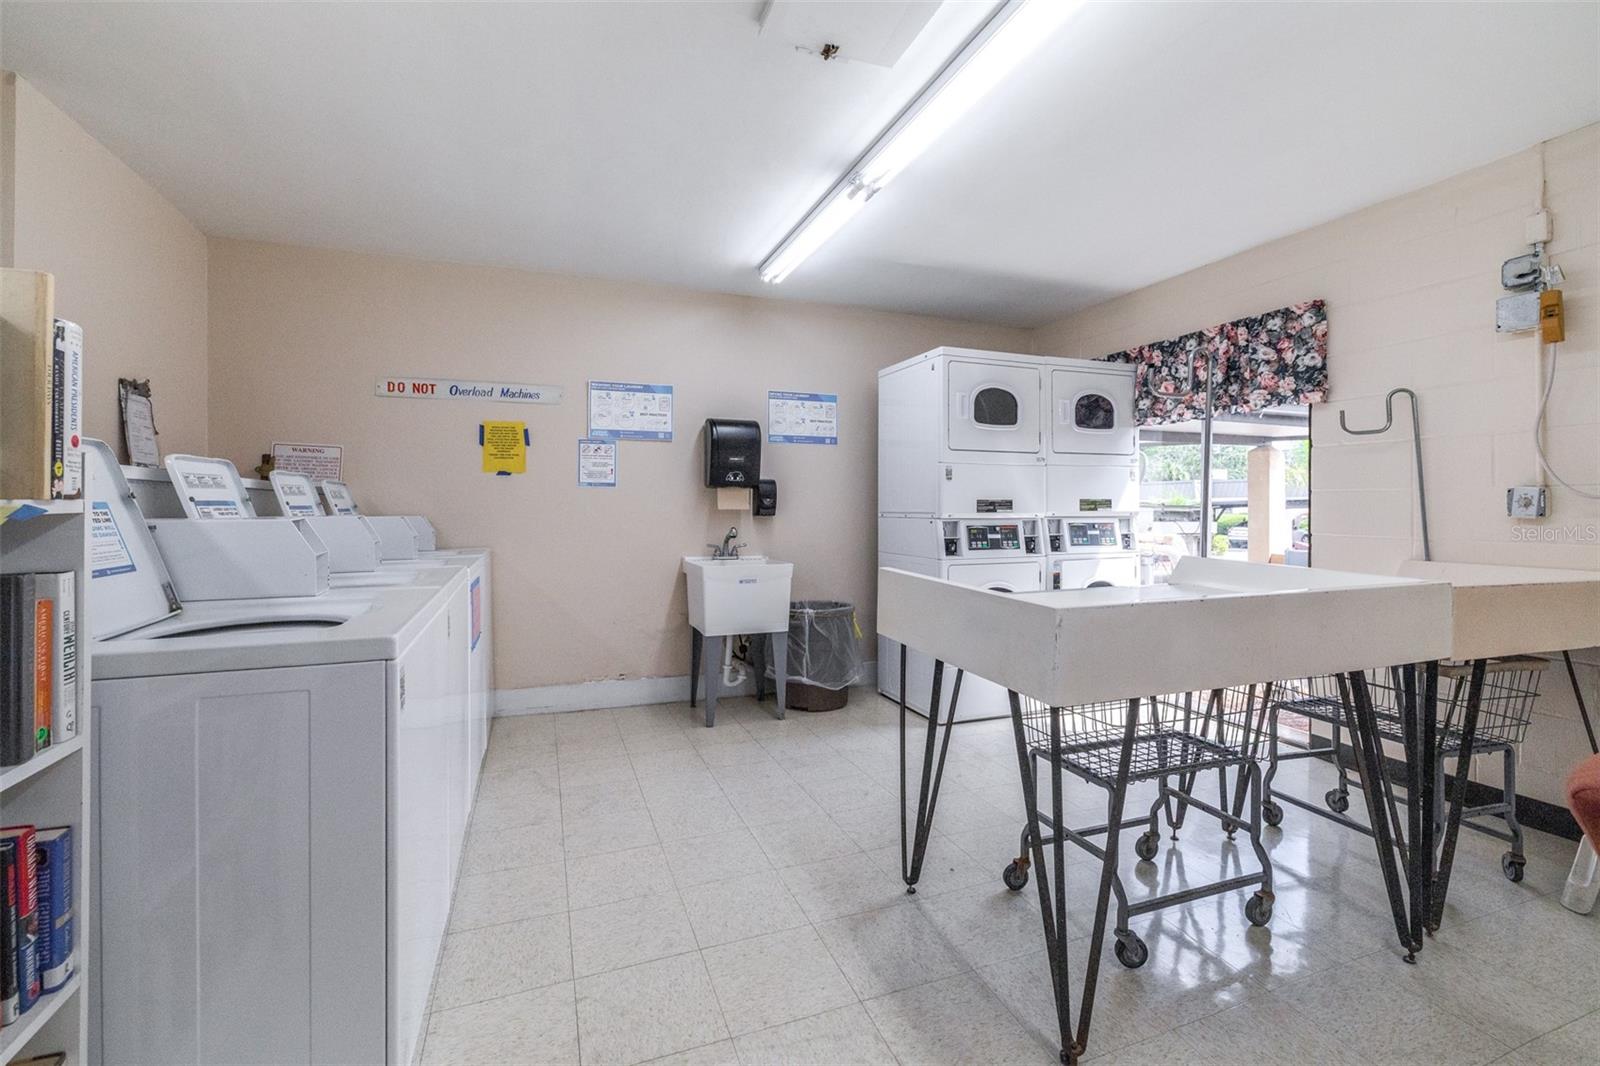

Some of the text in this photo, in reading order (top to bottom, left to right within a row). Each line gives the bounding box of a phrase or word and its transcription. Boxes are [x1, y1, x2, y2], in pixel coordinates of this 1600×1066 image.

[70, 350, 79, 431] AMERICAN PRESIDENTS
[387, 381, 541, 400] DO NOT Overload Machines
